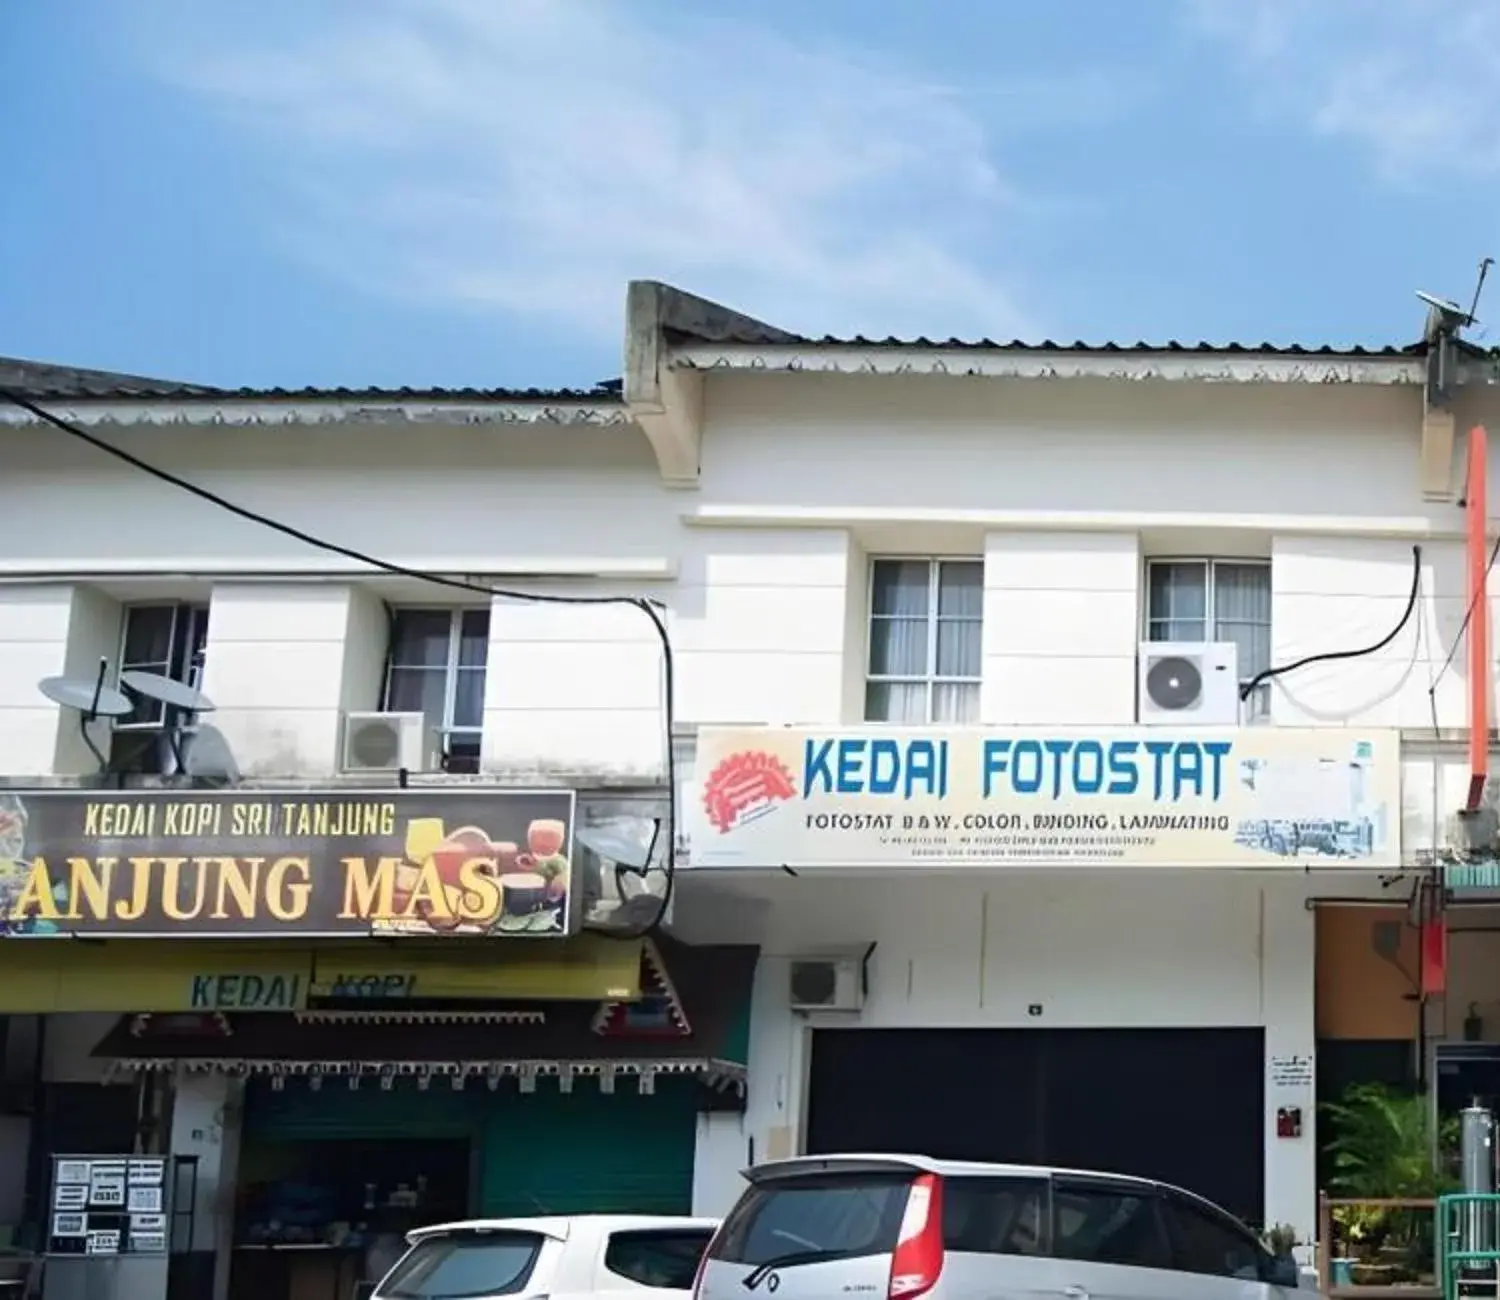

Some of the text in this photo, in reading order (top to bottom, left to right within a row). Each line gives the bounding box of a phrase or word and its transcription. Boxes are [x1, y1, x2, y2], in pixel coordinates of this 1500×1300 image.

[803, 738, 1233, 801] KEDAI FOTOSTAT
[84, 802, 395, 836] KEDAI KOPI SRI TANJUNG
[336, 857, 502, 922] MAS
[190, 974, 300, 1008] KEDAI
